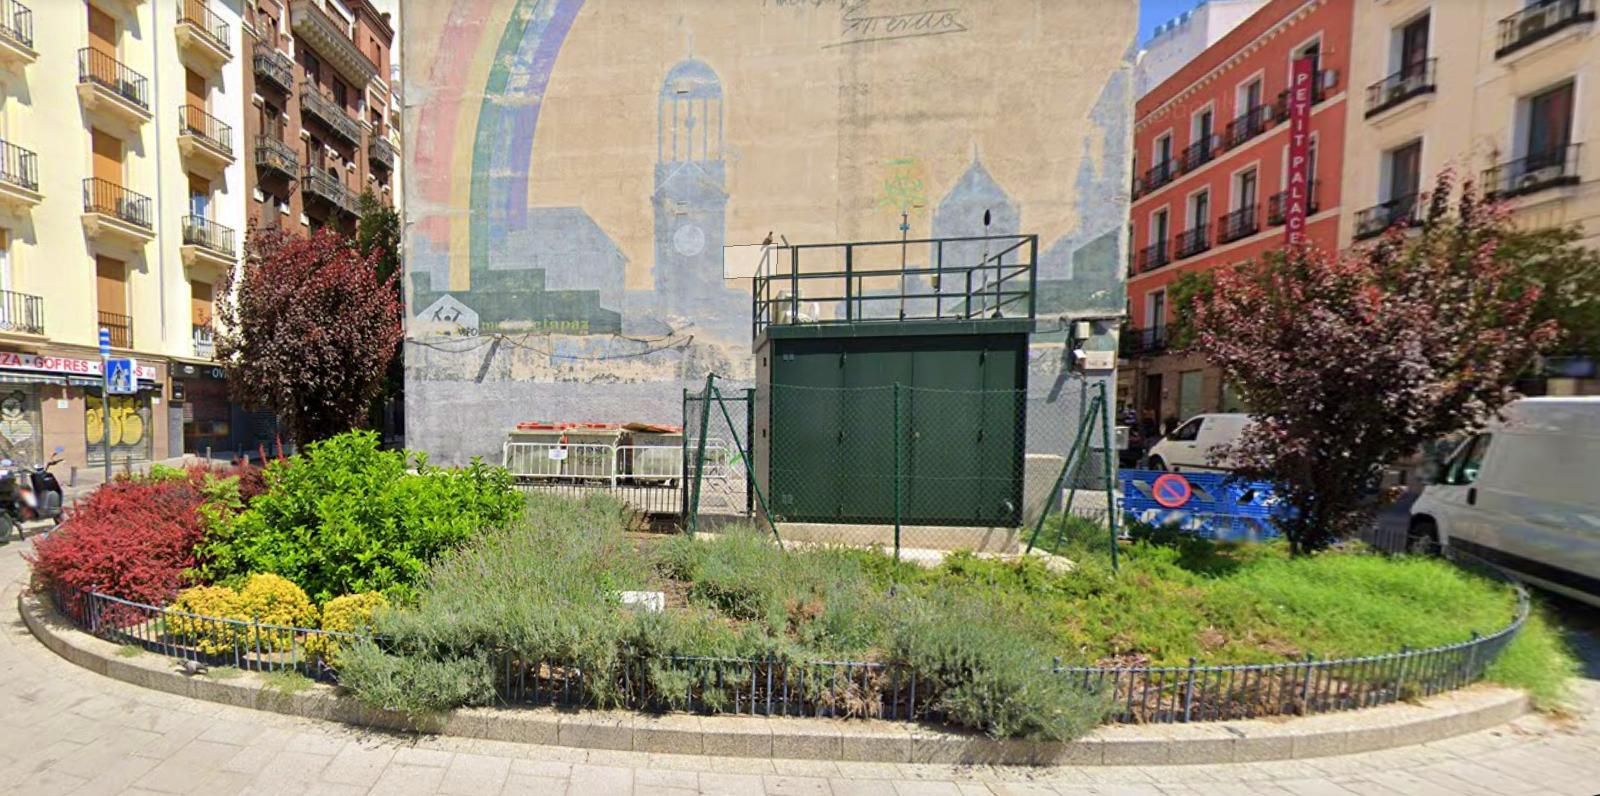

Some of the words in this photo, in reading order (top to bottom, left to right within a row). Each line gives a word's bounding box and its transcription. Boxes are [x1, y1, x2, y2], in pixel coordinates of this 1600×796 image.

[1294, 73, 1308, 146] PETIT
[1289, 156, 1304, 244] PALACE
[0, 352, 21, 366] ZA
[34, 356, 89, 373] GOFRES
